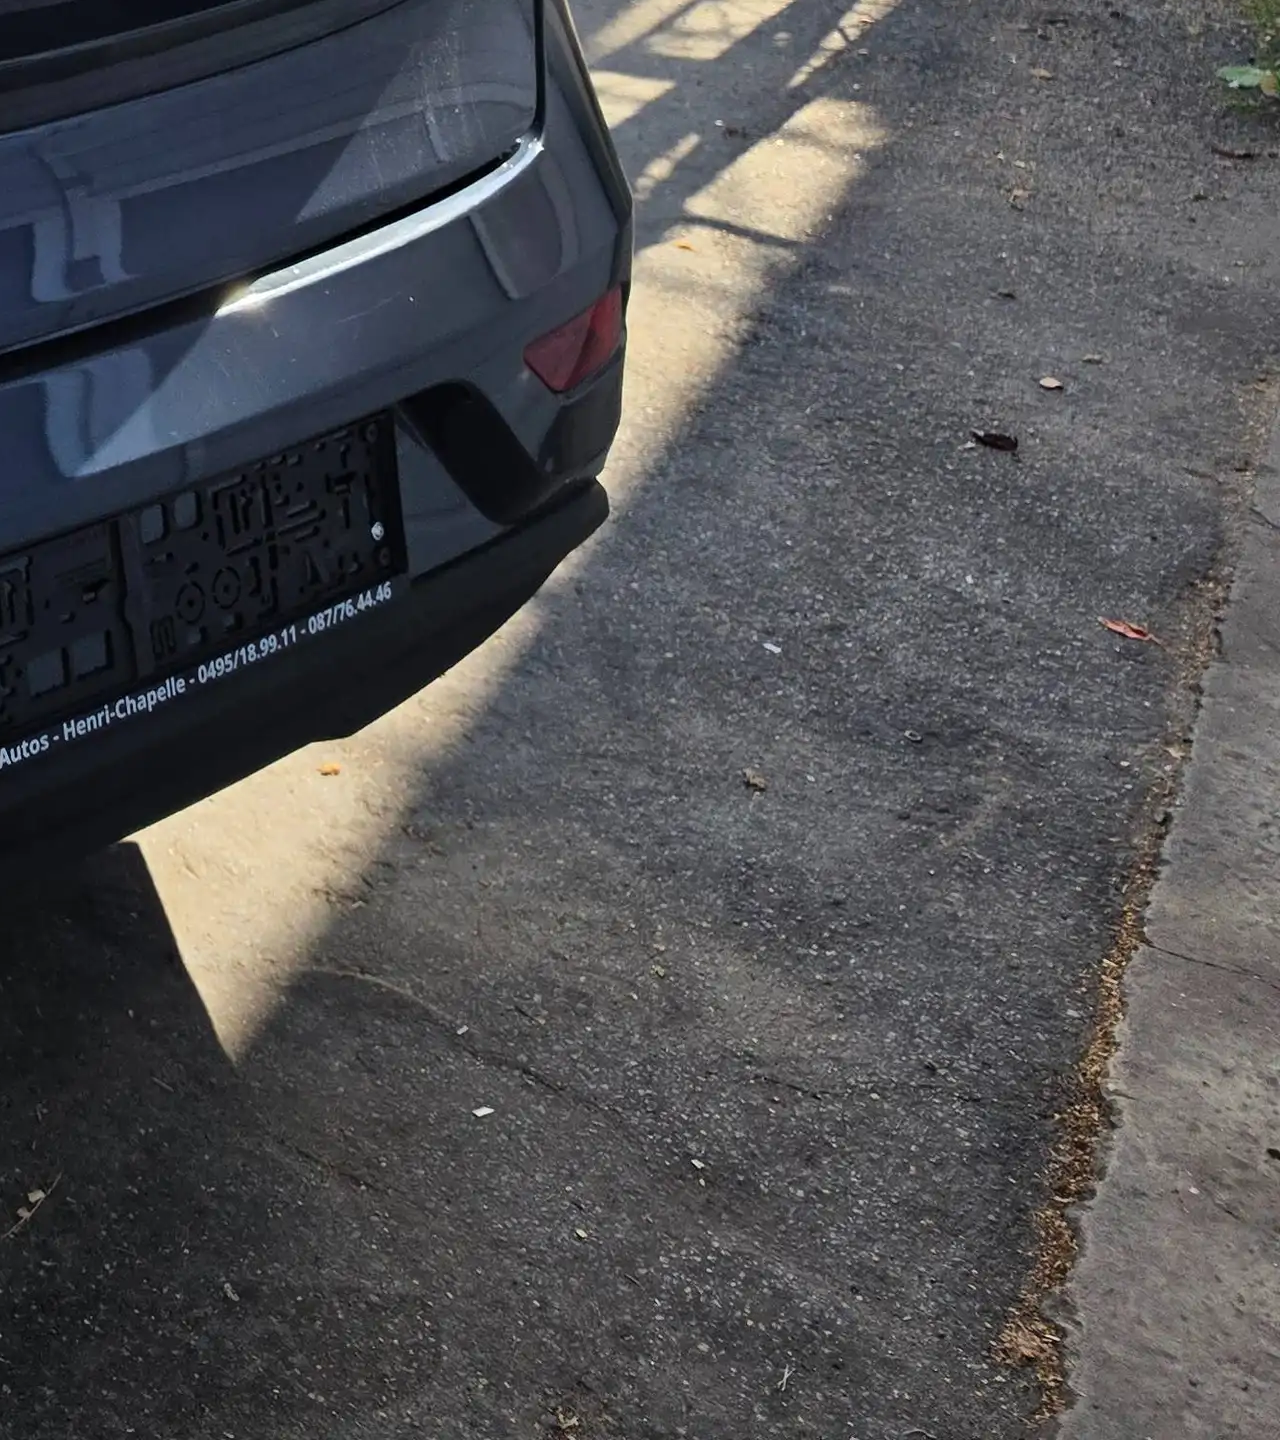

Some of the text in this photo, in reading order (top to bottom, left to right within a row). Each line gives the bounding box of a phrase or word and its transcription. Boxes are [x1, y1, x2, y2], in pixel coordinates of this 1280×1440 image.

[63, 676, 186, 742] Henri-Chapelle
[198, 625, 297, 684] 0495/18.99.11
[308, 581, 392, 635] 087/76.44.46
